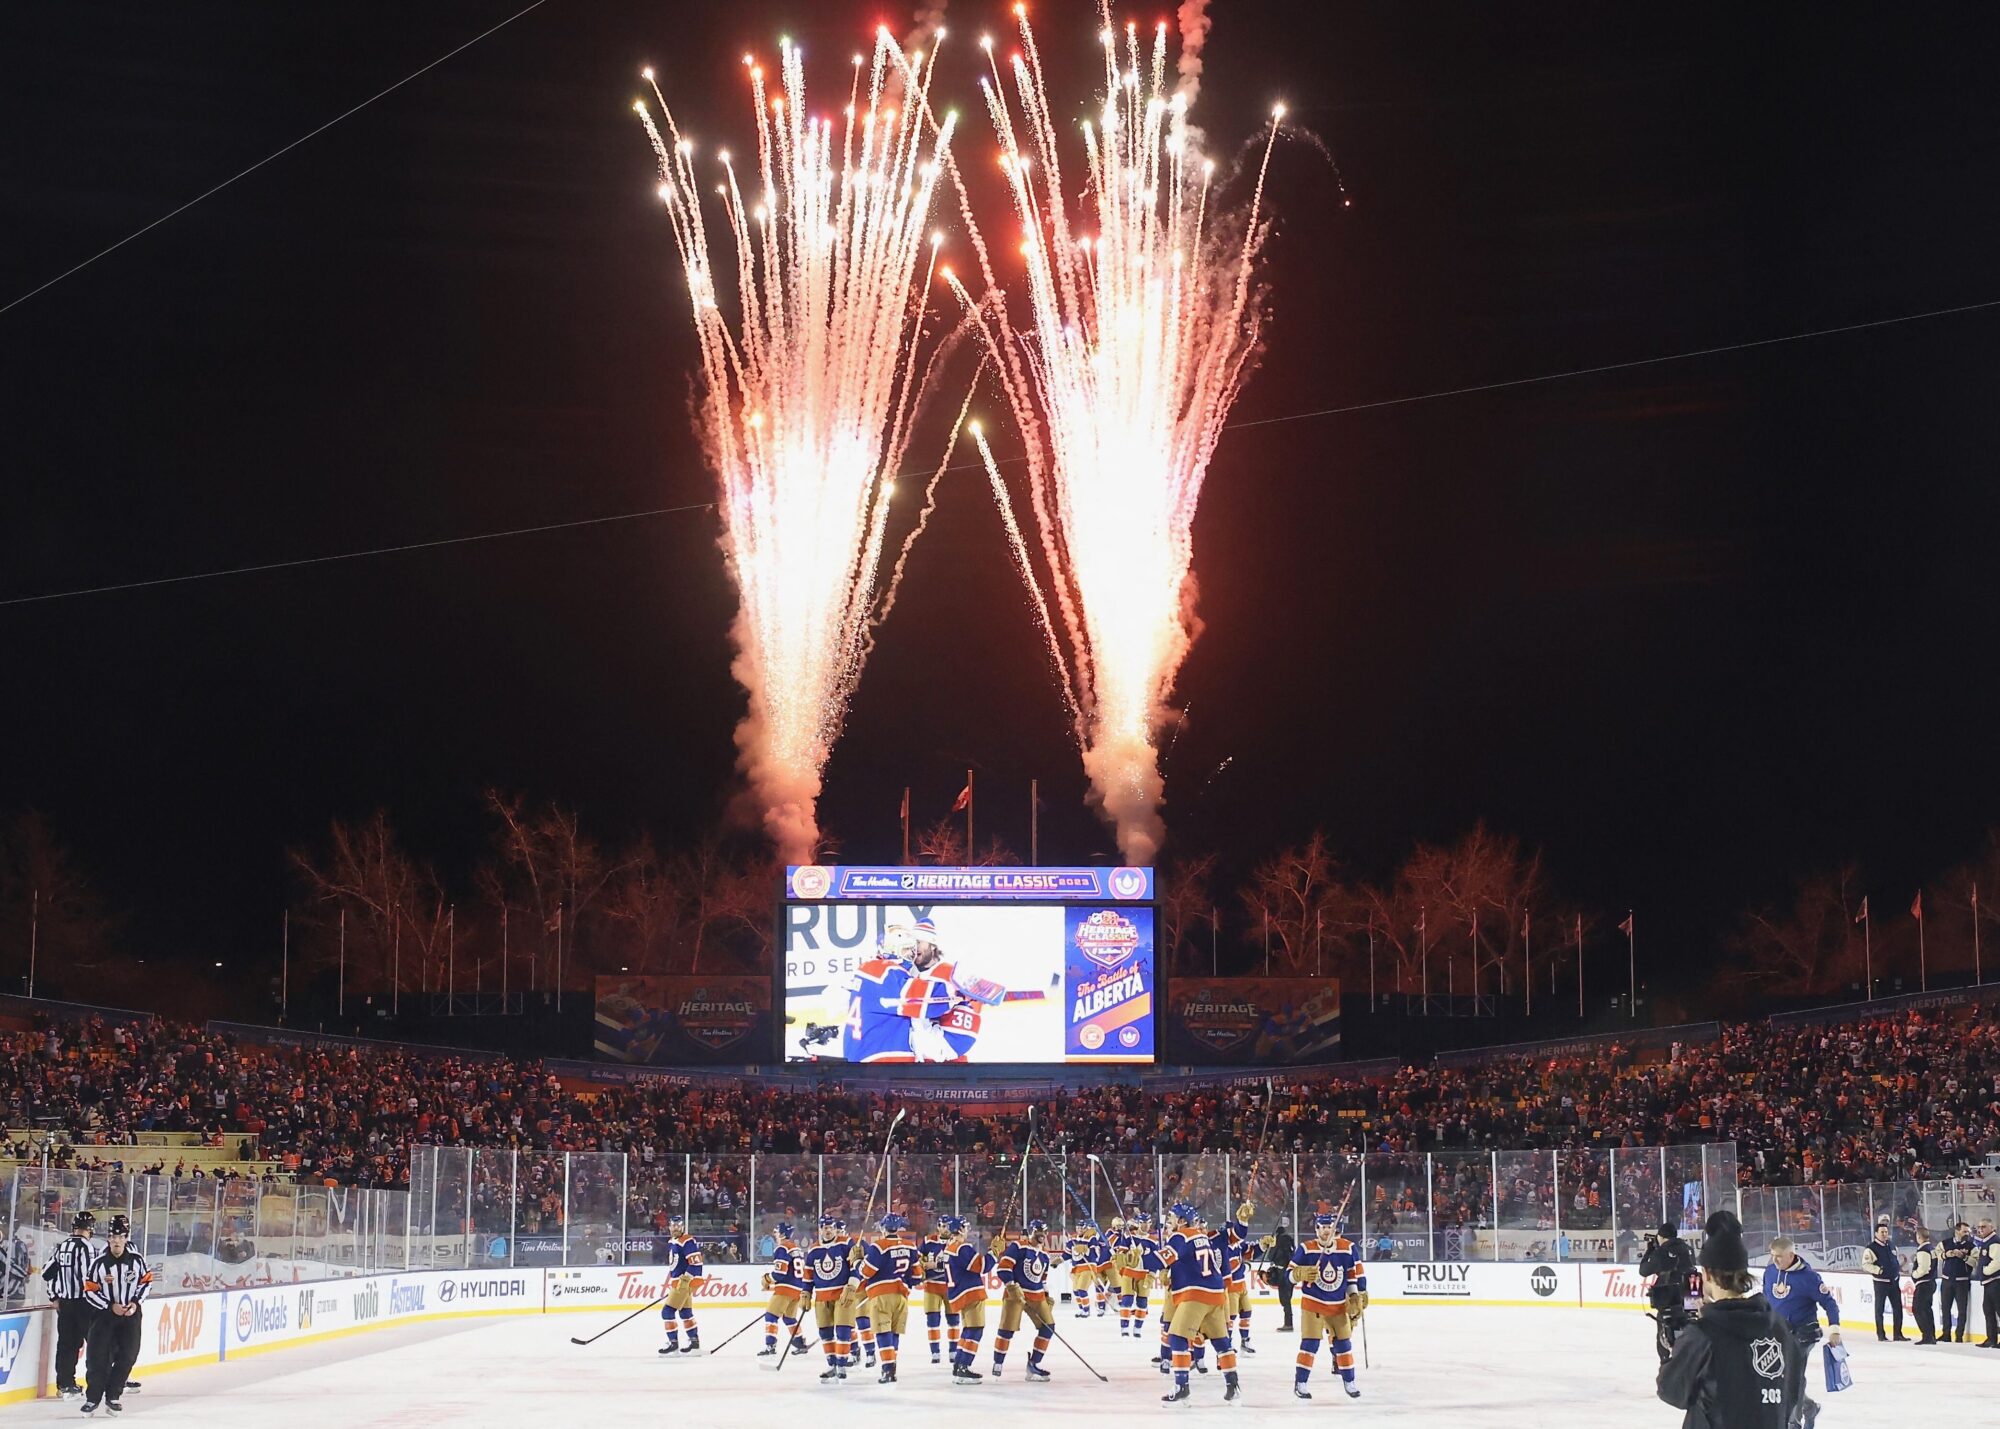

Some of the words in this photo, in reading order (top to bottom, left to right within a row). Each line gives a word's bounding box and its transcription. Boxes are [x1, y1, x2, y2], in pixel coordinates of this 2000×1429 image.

[916, 875, 991, 889] HERITAGE
[994, 875, 1058, 890] CLASSIC
[1058, 878, 1090, 886] 2023
[1077, 980, 1096, 998] The
[1097, 966, 1128, 989] Battle
[1128, 960, 1140, 976] of
[1072, 972, 1145, 1024] ALBERTA
[678, 1001, 756, 1016] HERITAGE
[1183, 1002, 1259, 1017] HERITAGE
[637, 1073, 691, 1086] HERITAGE
[1233, 1074, 1286, 1087] HERITGE
[936, 1090, 989, 1099] HERITAGE
[521, 1241, 536, 1252] Tim
[605, 1240, 653, 1252] ROGERS
[59, 1253, 72, 1266] 90
[1324, 1270, 1334, 1278] 27
[1402, 1265, 1471, 1282] TRULY
[460, 1279, 525, 1299] HYUNDAI
[617, 1271, 656, 1299] Tim
[661, 1272, 748, 1297] Htons
[1531, 1275, 1558, 1290] TNT
[1603, 1269, 1637, 1298] Tim
[353, 1280, 379, 1321] voilà
[239, 1306, 251, 1328] Esso
[254, 1295, 287, 1333] Medals
[298, 1289, 314, 1330] CAT
[170, 1298, 204, 1353] SKIP
[1760, 1347, 1778, 1371] NHL
[1761, 1388, 1782, 1404] 203
